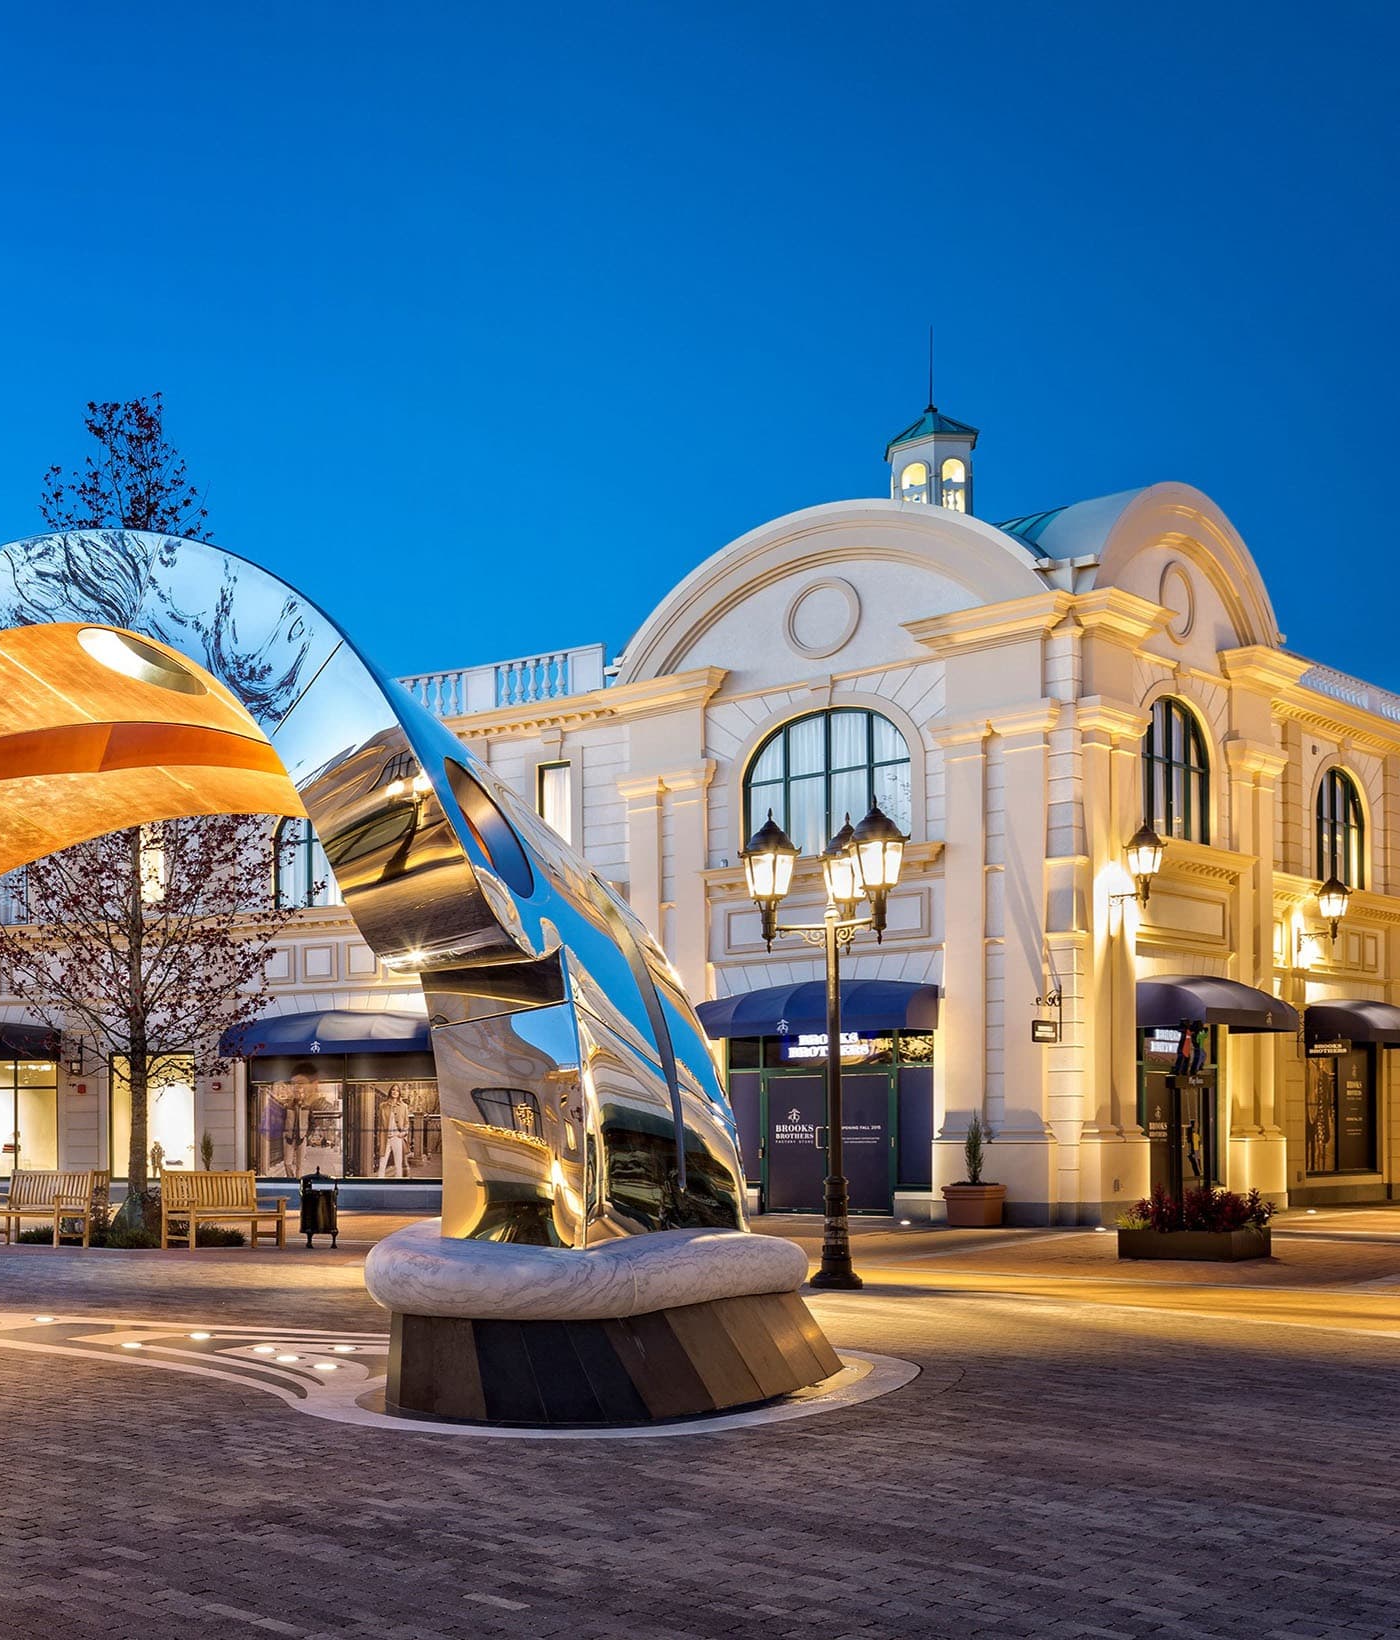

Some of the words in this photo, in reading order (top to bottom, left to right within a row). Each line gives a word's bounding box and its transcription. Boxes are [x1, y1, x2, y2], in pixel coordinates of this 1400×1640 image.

[798, 1032, 859, 1046] BROKS
[788, 1044, 870, 1058] BROTERS
[775, 1124, 814, 1133] BROOKS
